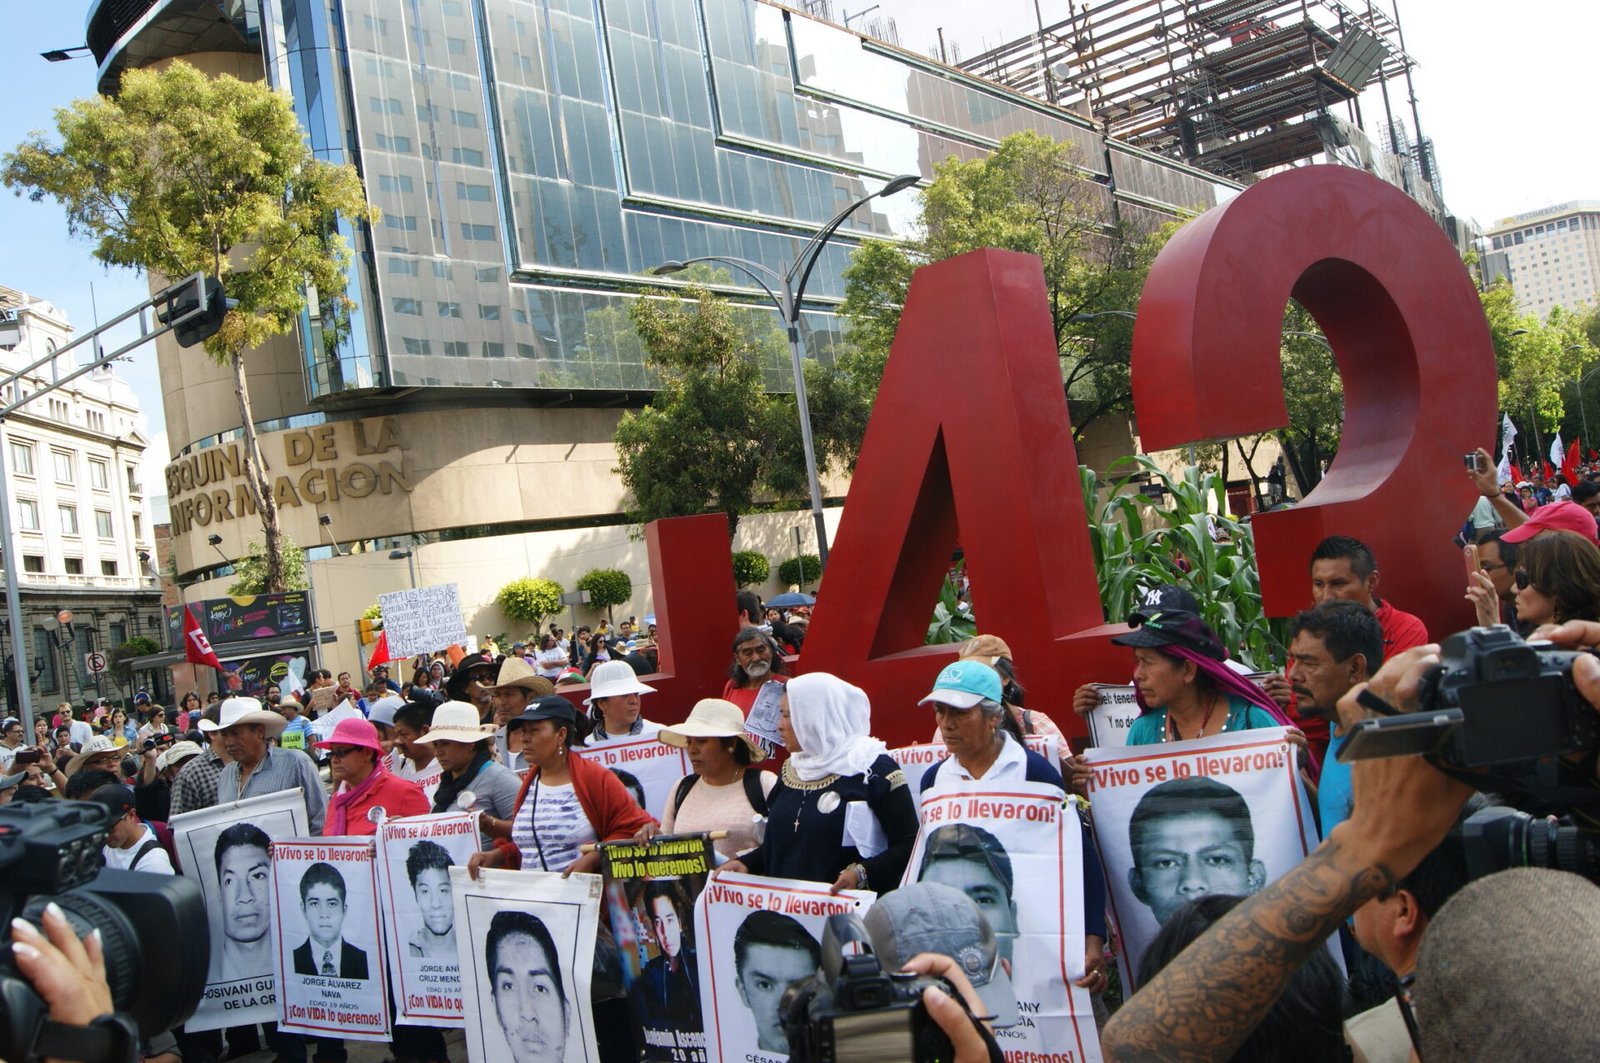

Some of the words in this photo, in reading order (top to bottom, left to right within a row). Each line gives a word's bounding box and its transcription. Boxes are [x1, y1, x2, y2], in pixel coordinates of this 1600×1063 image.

[166, 444, 269, 499] ESQUINA
[283, 426, 338, 467] DE
[352, 416, 406, 456] LA
[170, 460, 413, 537] INFORMACION
[1107, 715, 1113, 728] Y
[1115, 718, 1124, 728] no
[604, 751, 617, 765] lo
[895, 750, 934, 766] ¡Vivo
[1089, 766, 1140, 792] ¡Vivo
[1145, 765, 1167, 783] se
[1172, 759, 1190, 780] lo
[930, 806, 943, 823] se
[947, 801, 962, 819] lo
[967, 799, 1056, 823] llevaron!
[385, 824, 406, 842] ¡Vivo
[408, 828, 418, 839] se
[420, 824, 429, 838] lo
[431, 821, 473, 837] llevaron!
[275, 847, 302, 862] ¡Vivo
[304, 848, 314, 861] se
[317, 847, 326, 861] lo
[328, 847, 370, 862] llevaron!
[611, 861, 634, 879] Vivo
[634, 860, 646, 878] lo
[646, 855, 707, 877] queremos!
[708, 885, 744, 906] ¡Vivo
[748, 893, 762, 909] se
[767, 892, 782, 911] lo
[420, 965, 444, 973] JORGE
[255, 979, 276, 992] GU
[302, 977, 327, 987] JORGE
[418, 974, 438, 983] CRUZ
[321, 989, 342, 999] NAVA
[408, 993, 425, 1010] ¡Con
[425, 995, 444, 1010] VIDA
[444, 995, 453, 1010] lo
[223, 1000, 241, 1011] DE
[242, 996, 259, 1008] LA
[309, 999, 328, 1007] EDAD
[329, 1001, 338, 1009] 19
[339, 1002, 359, 1010] AÑOS
[289, 1004, 306, 1019] ¡Con
[307, 1006, 327, 1021] VIDA
[327, 1008, 336, 1022] lo
[337, 1010, 382, 1026] queremos!
[671, 1048, 687, 1062] 20
[1004, 1049, 1075, 1063] ueremos!
